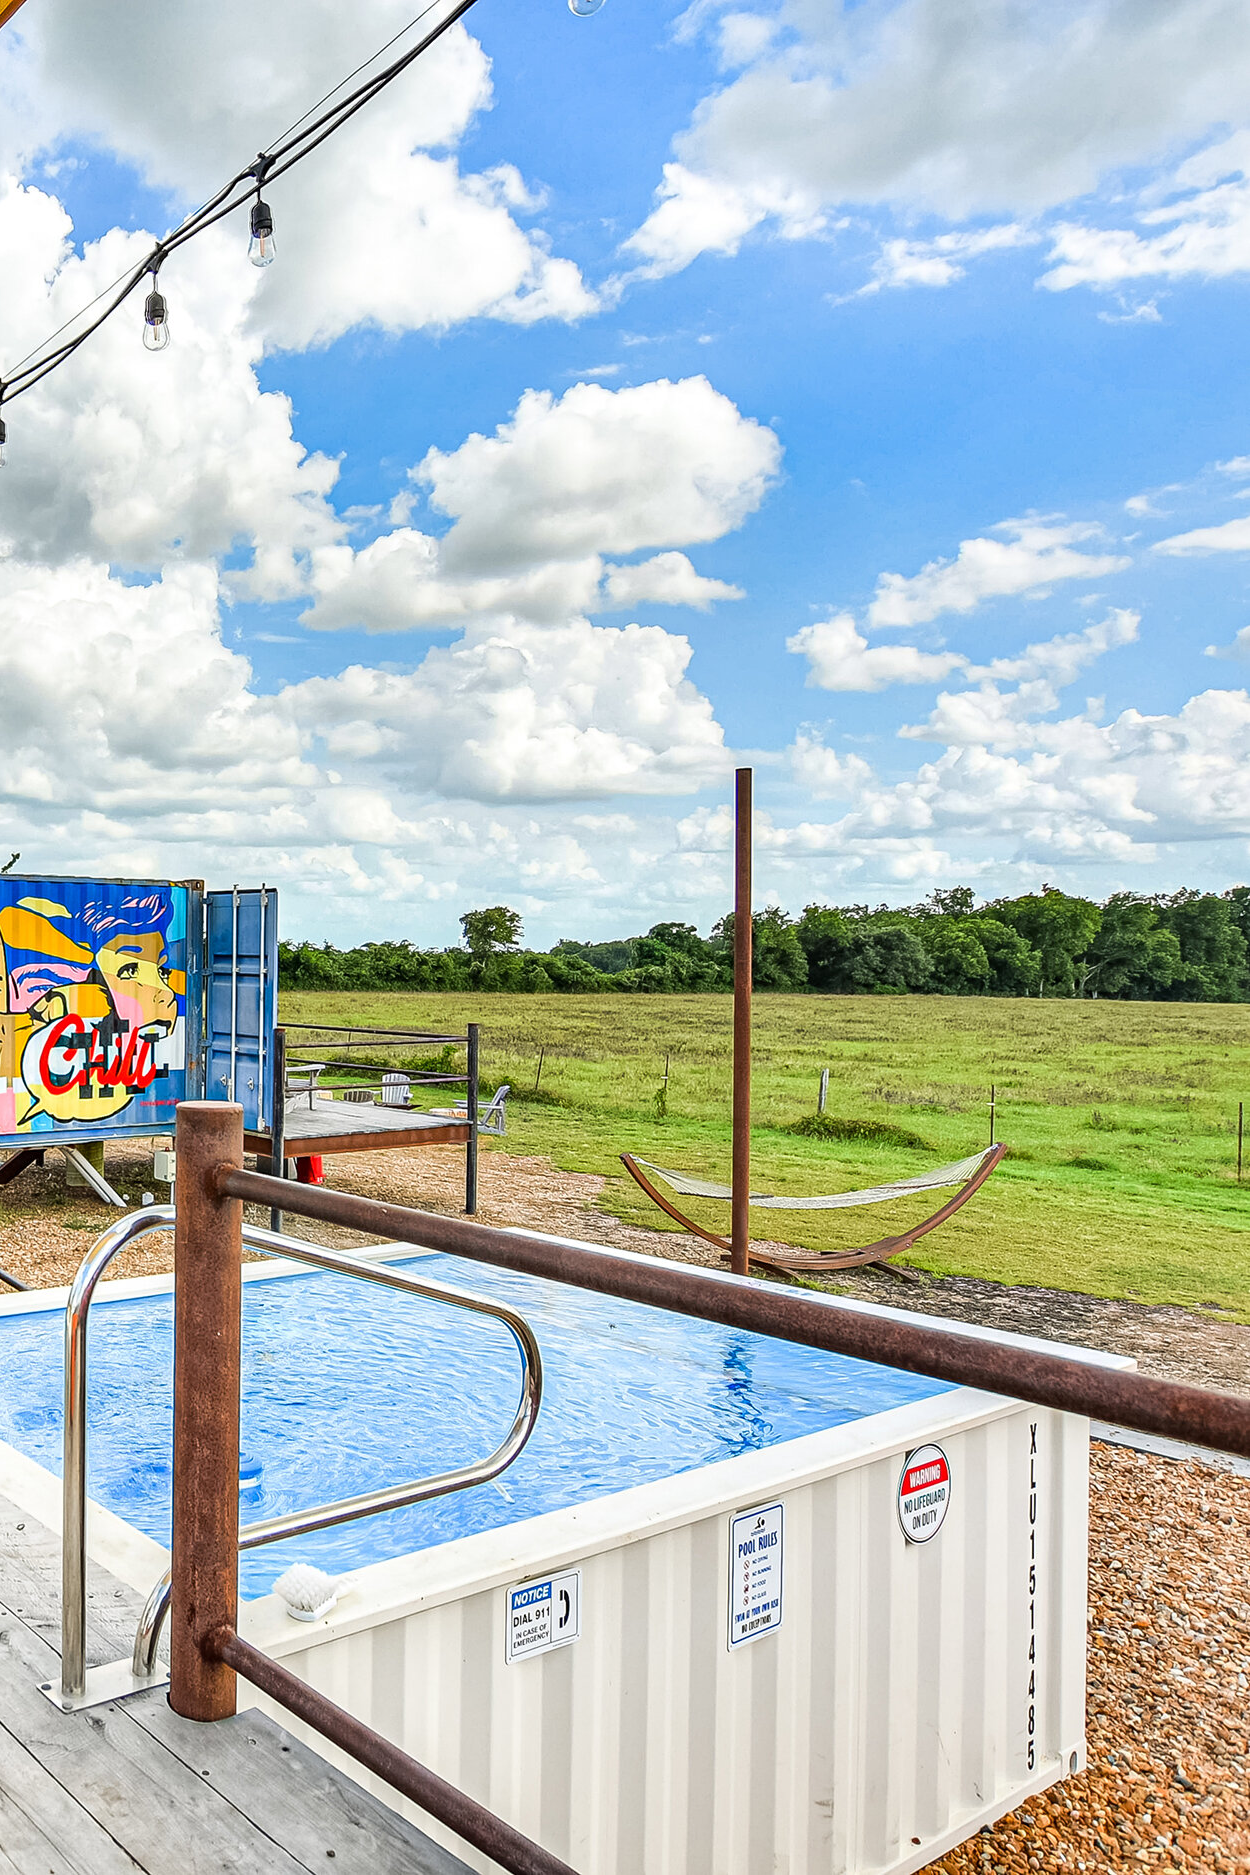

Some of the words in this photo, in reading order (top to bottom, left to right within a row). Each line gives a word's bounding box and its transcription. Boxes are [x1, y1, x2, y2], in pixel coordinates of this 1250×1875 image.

[909, 1463, 941, 1489] WARNING
[904, 1500, 913, 1515] NO
[914, 1488, 946, 1511] LIFEGUARD
[912, 1514, 921, 1530] ON
[921, 1509, 938, 1527] DUTY
[738, 1539, 756, 1559] POOL
[758, 1530, 778, 1551] RULES
[513, 1585, 550, 1608] NOTICE
[513, 1612, 533, 1628] DIAL
[535, 1606, 550, 1620] 911
[513, 1631, 550, 1649] EMERGENCY
[516, 1631, 522, 1640] IN
[522, 1626, 538, 1637] CASE
[539, 1623, 547, 1631] OF
